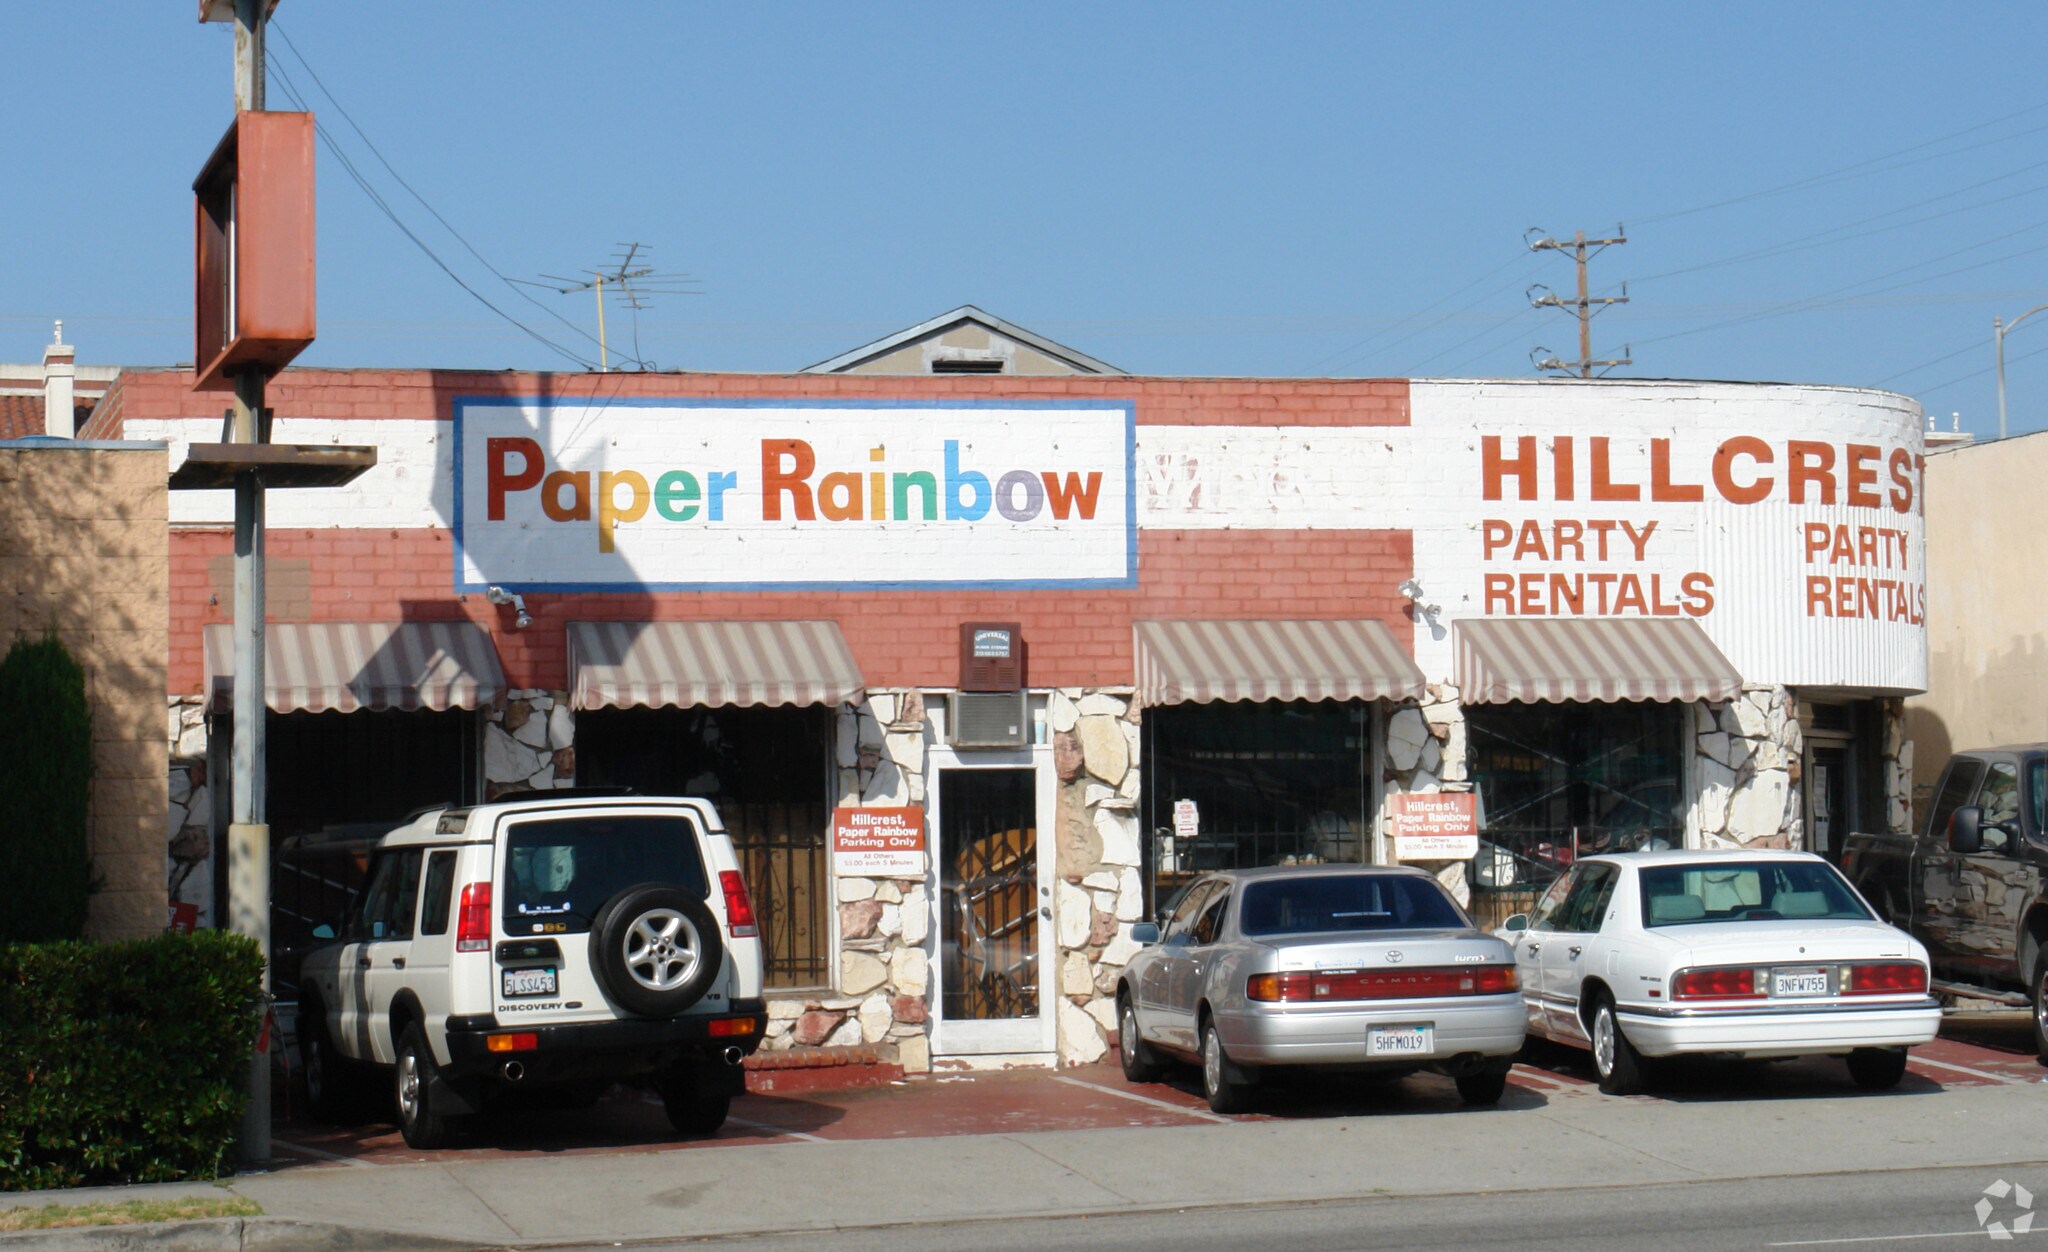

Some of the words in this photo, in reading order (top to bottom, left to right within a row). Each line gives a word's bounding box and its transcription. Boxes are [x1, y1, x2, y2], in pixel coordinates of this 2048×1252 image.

[487, 437, 737, 553] Paper
[761, 438, 1103, 522] Rainbow
[1482, 519, 1659, 562] PARTY
[1805, 522, 1908, 570] PARTY
[1484, 572, 1714, 617] RENTALS
[1806, 575, 1924, 627] RENTALS
[1406, 801, 1459, 812] Hillcrest,
[851, 814, 906, 827] Hillcrest,
[1396, 813, 1424, 824] Paper
[1428, 812, 1471, 822] Rainbow
[838, 826, 869, 838] Paper
[874, 826, 918, 836] Rainbow
[1399, 823, 1440, 832] Parking
[1444, 822, 1469, 832] Only
[840, 838, 885, 847] Parking
[889, 837, 916, 847] Only
[505, 976, 555, 993] 5LSS453
[1359, 976, 1432, 984] CAMRY
[1779, 977, 1825, 991] 3NFW755
[498, 1002, 562, 1012] DISCOVERY
[1376, 1035, 1423, 1050] 5HFM019
